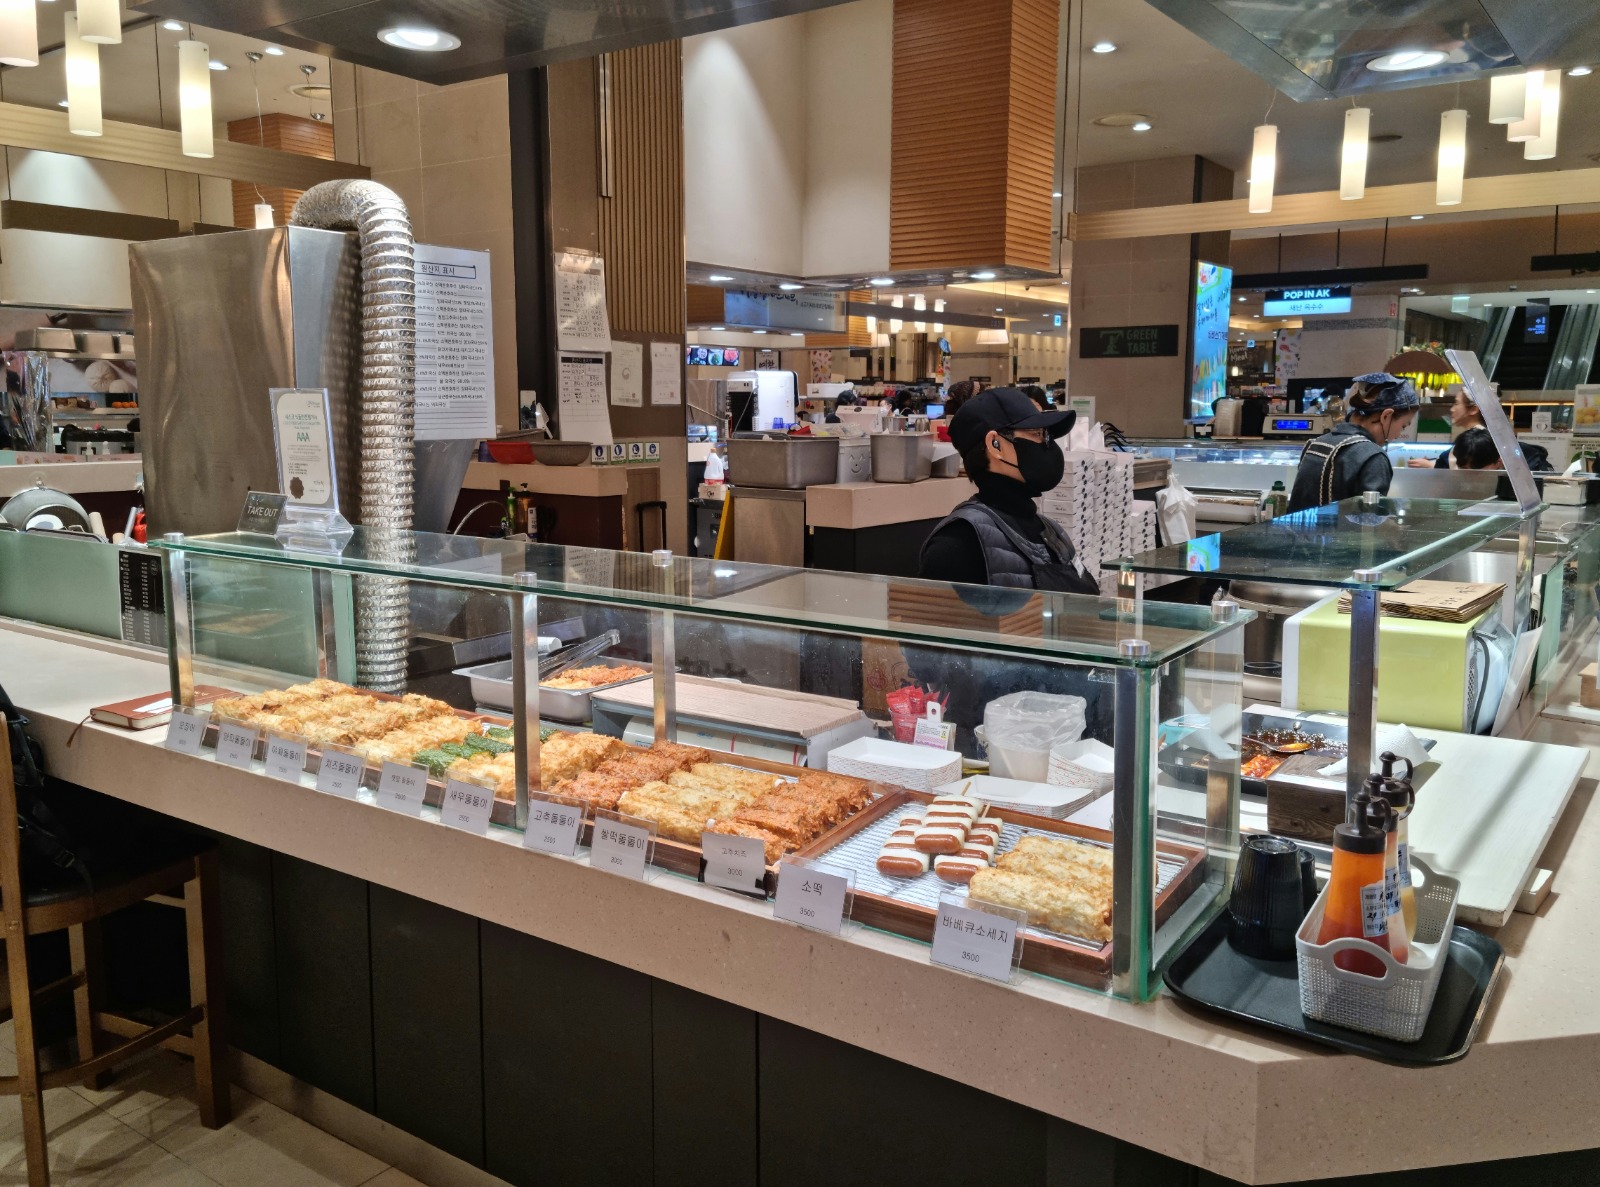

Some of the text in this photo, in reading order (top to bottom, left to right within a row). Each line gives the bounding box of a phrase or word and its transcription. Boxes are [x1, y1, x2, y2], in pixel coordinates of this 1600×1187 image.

[421, 264, 455, 276] 원산지 표시
[1283, 288, 1331, 300] POP IN AK
[1304, 303, 1324, 311] 옥수수
[1126, 328, 1159, 340] GREEN
[1127, 341, 1158, 355] TABLE
[296, 431, 310, 442] AAA
[247, 505, 279, 518] TAKE OUT
[727, 867, 743, 877] 3000
[801, 880, 823, 896] 소떡
[799, 907, 815, 918] 3500
[942, 915, 1009, 943] 바베큐소세지
[961, 951, 980, 963] 3500
